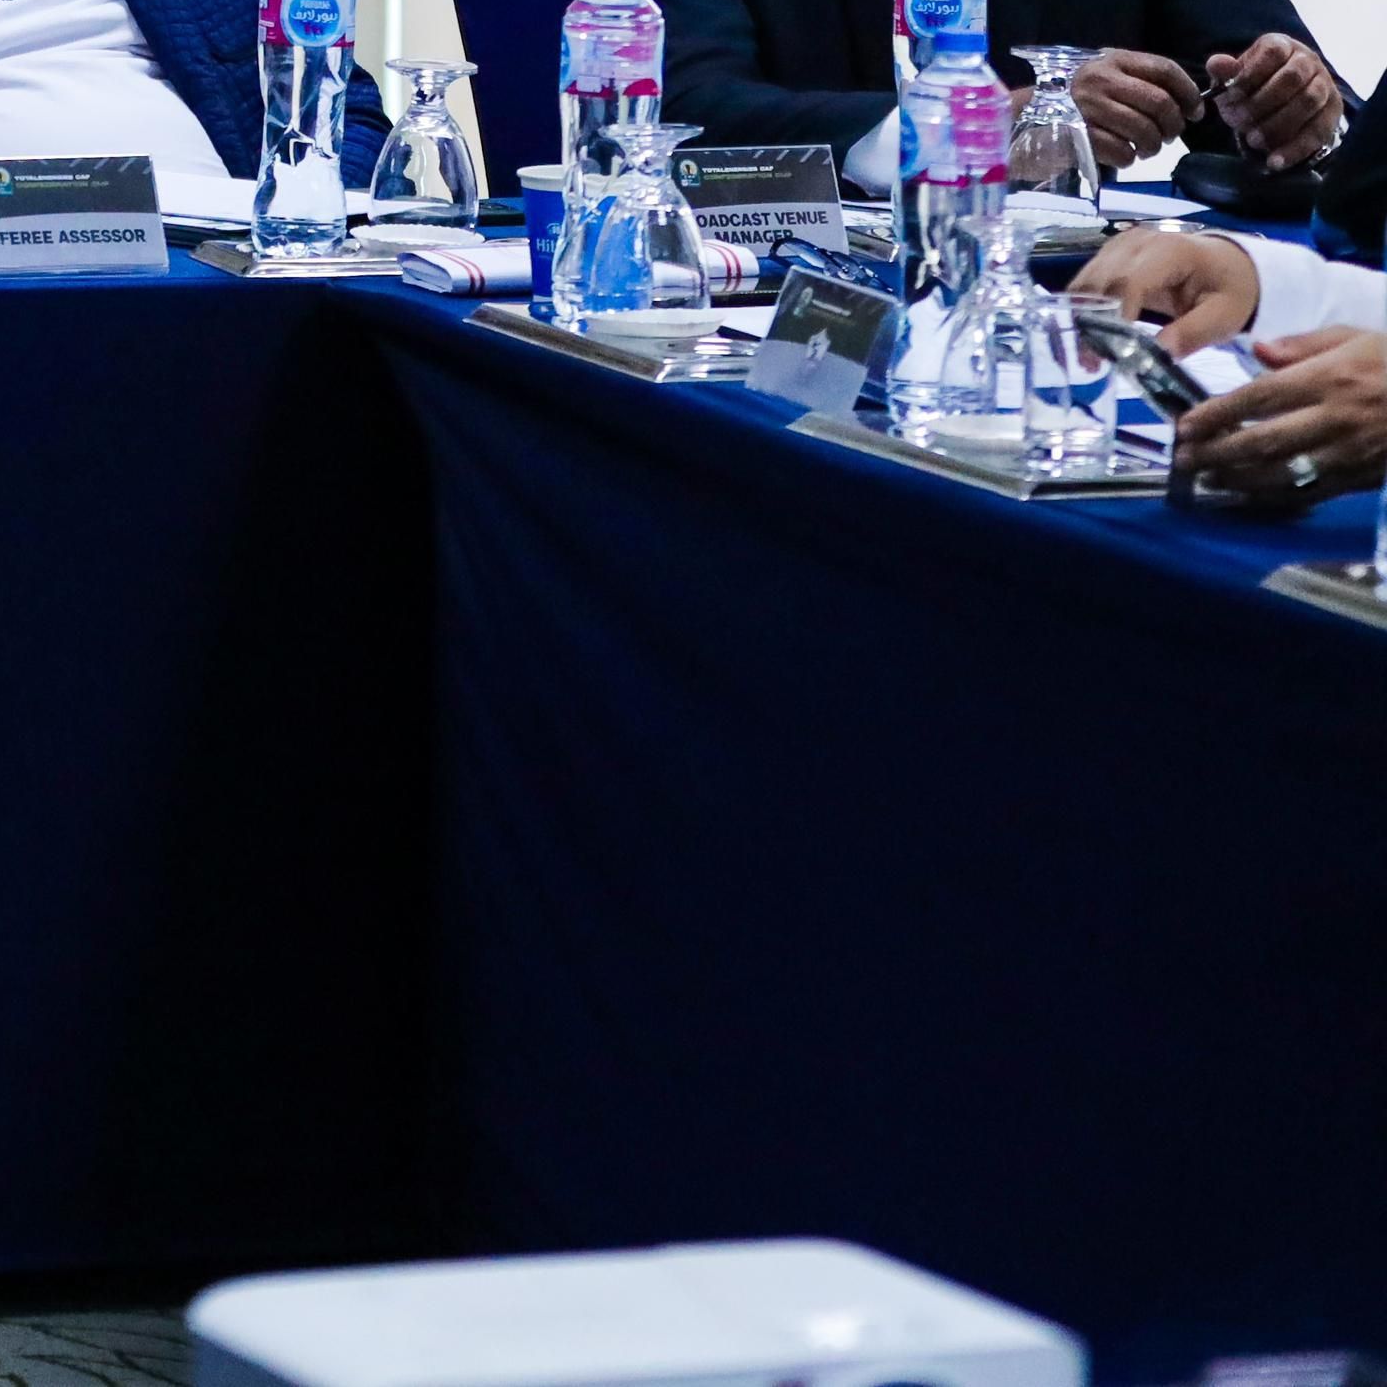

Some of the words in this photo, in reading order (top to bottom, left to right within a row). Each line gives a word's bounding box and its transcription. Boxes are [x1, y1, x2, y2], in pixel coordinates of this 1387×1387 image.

[695, 212, 770, 228] OADCAST
[772, 211, 829, 225] VENUE
[59, 228, 146, 244] ASSESSOR
